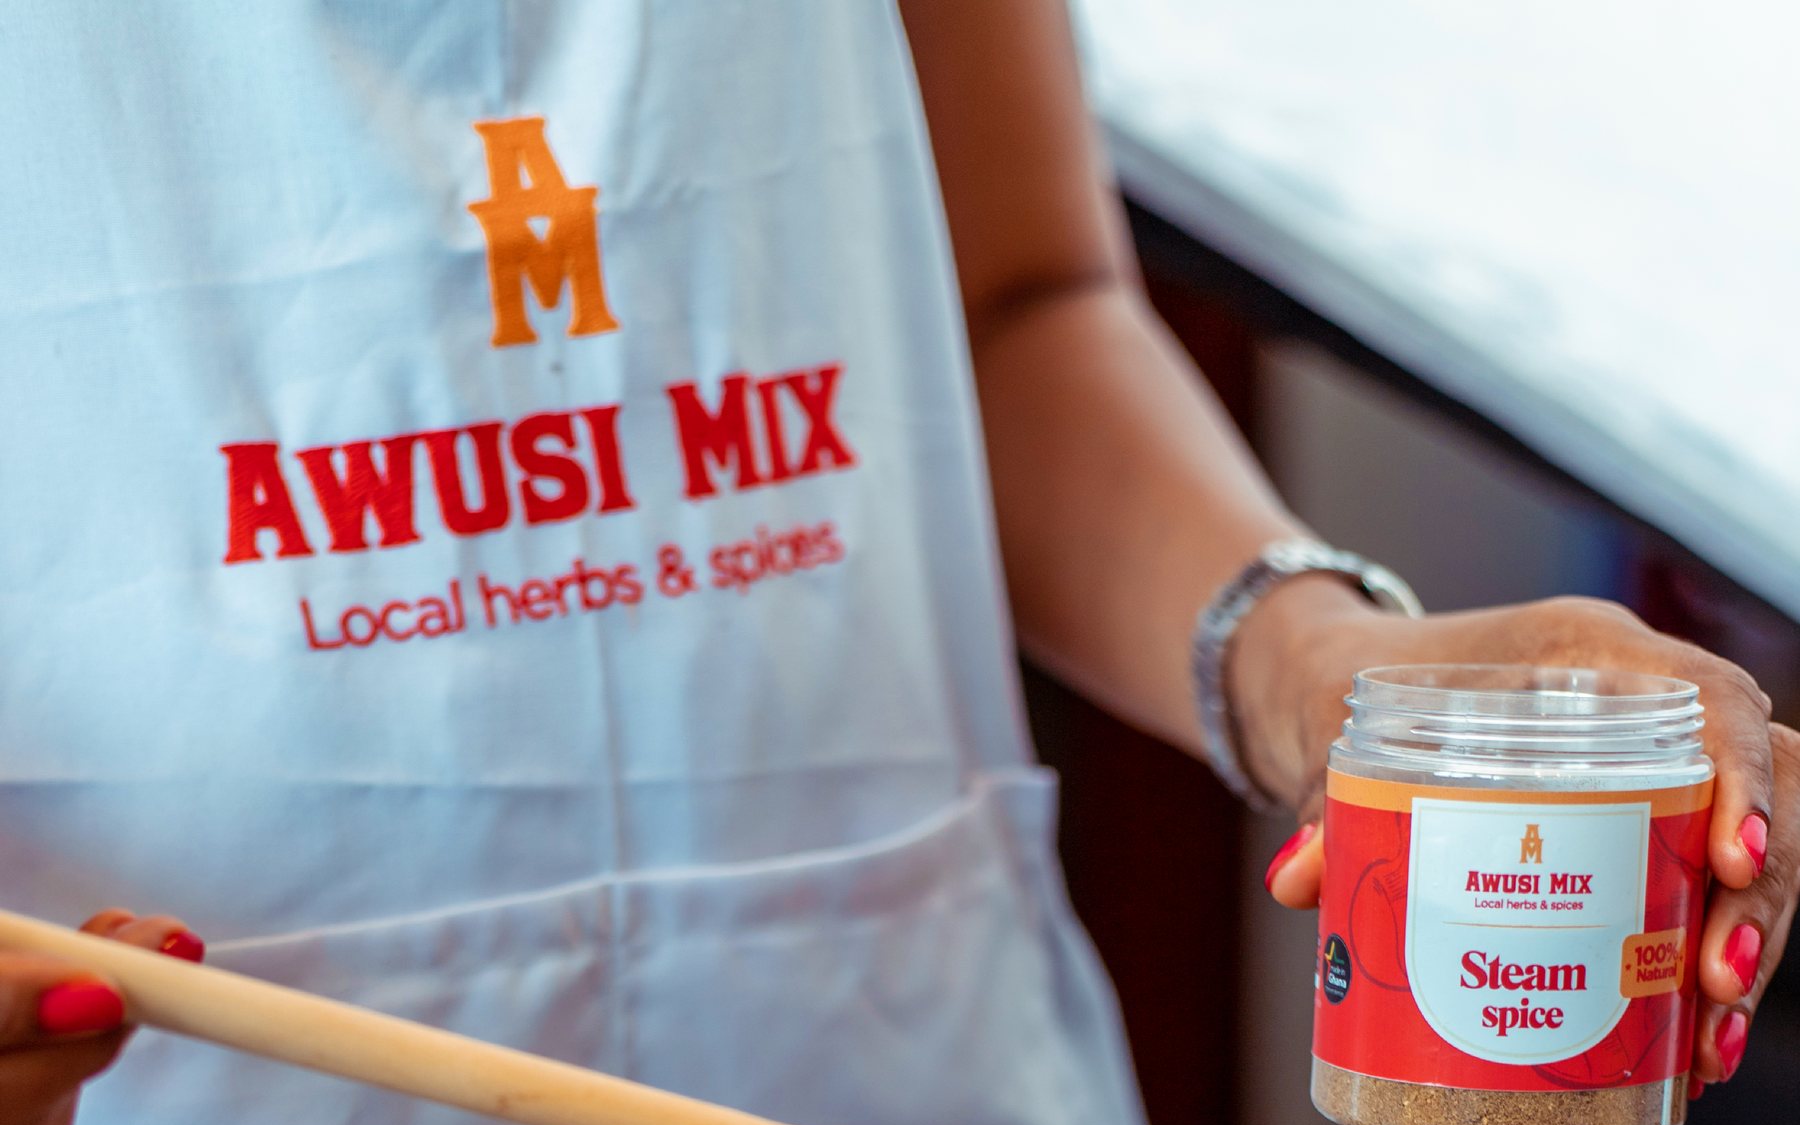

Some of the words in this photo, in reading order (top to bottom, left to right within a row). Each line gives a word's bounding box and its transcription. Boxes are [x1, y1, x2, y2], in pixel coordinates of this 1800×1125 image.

[220, 405, 637, 565] AWUSI
[666, 361, 858, 500] MIX
[300, 577, 464, 651] Local
[477, 560, 644, 629] herbs
[657, 545, 698, 598] &
[711, 520, 846, 594] spices
[1465, 871, 1540, 894] AWUSI
[1549, 872, 1593, 895] MIX
[1474, 898, 1504, 910] Local
[1506, 898, 1538, 911] herbs
[1540, 899, 1548, 911] &
[1550, 899, 1584, 913] spices
[1460, 950, 1588, 992] Steam
[1635, 942, 1679, 966] 100%
[1481, 998, 1564, 1037] spice
